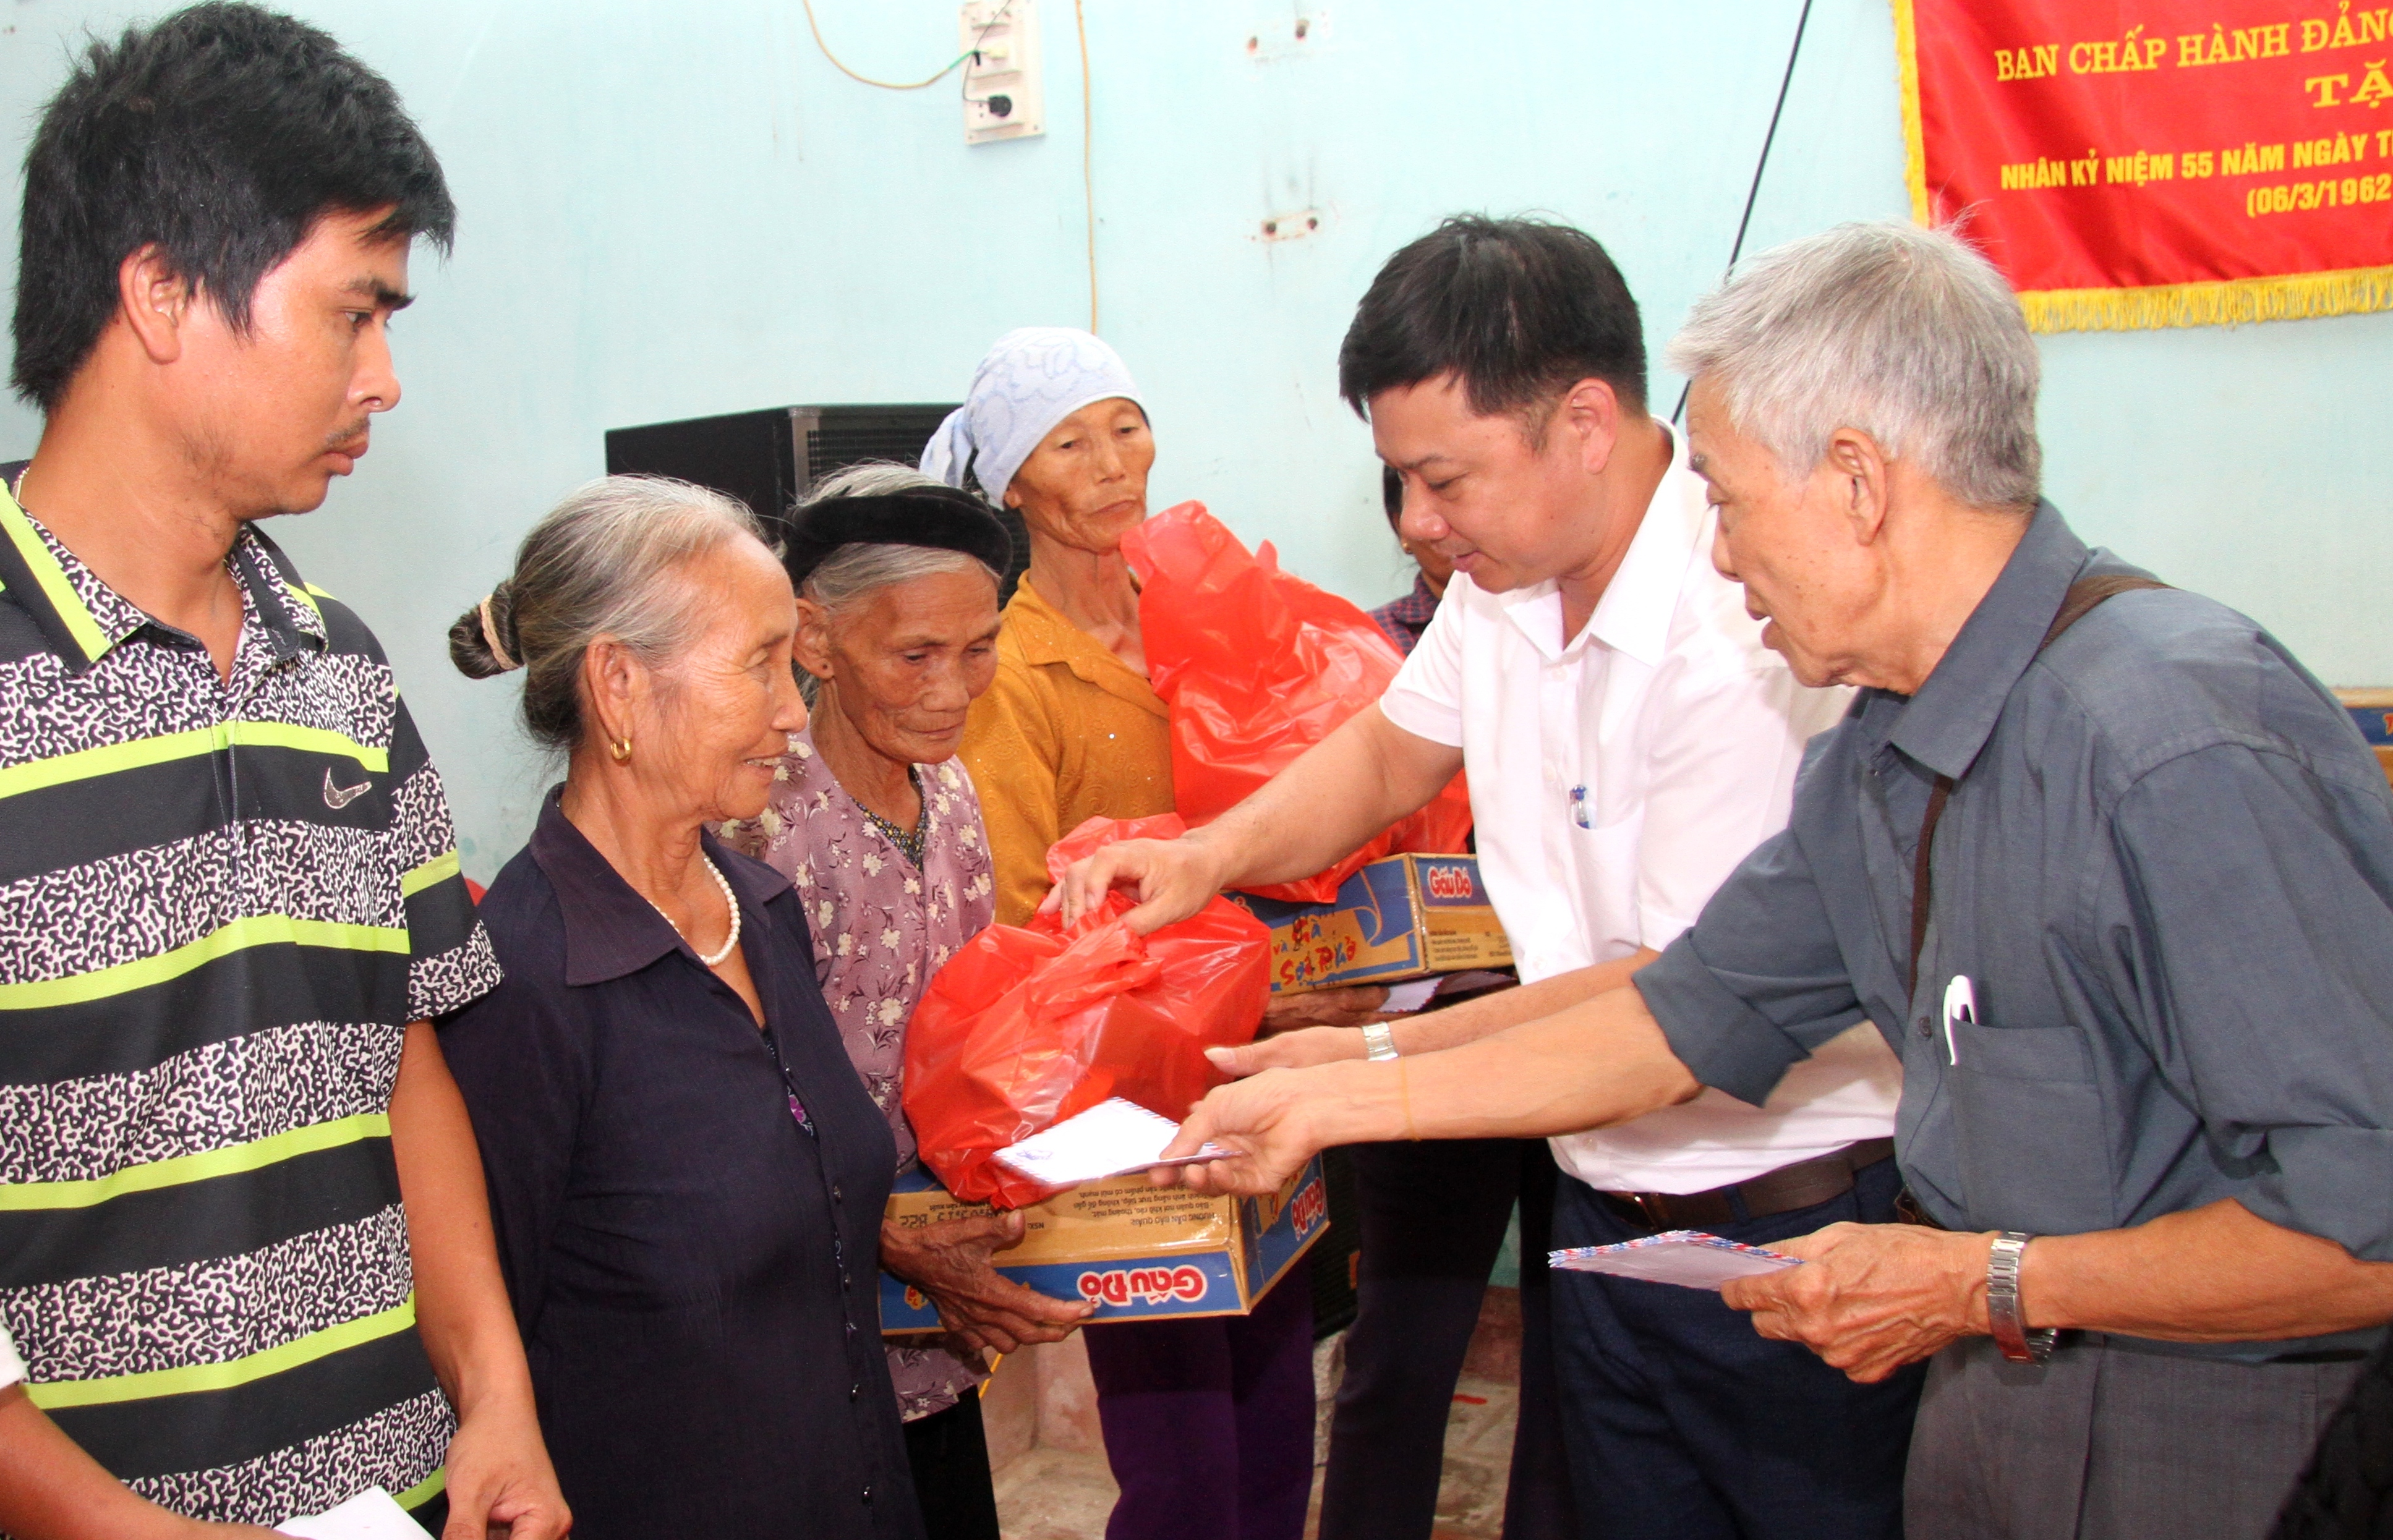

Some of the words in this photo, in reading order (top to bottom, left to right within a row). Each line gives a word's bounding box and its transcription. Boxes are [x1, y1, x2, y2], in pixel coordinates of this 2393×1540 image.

[1994, 44, 2060, 82] BAN
[2069, 23, 2167, 75] CHẤP
[2177, 22, 2290, 67] HÀNH
[2300, 0, 2393, 53] ĐẢN
[2001, 156, 2067, 190] NHÂN
[2071, 148, 2099, 186] KỶ
[2105, 150, 2173, 187] NIỆM
[2181, 150, 2214, 179] 55
[2221, 142, 2285, 177] NĂM
[2293, 131, 2368, 169] NGÀY
[2246, 173, 2392, 218] (06/3/1962
